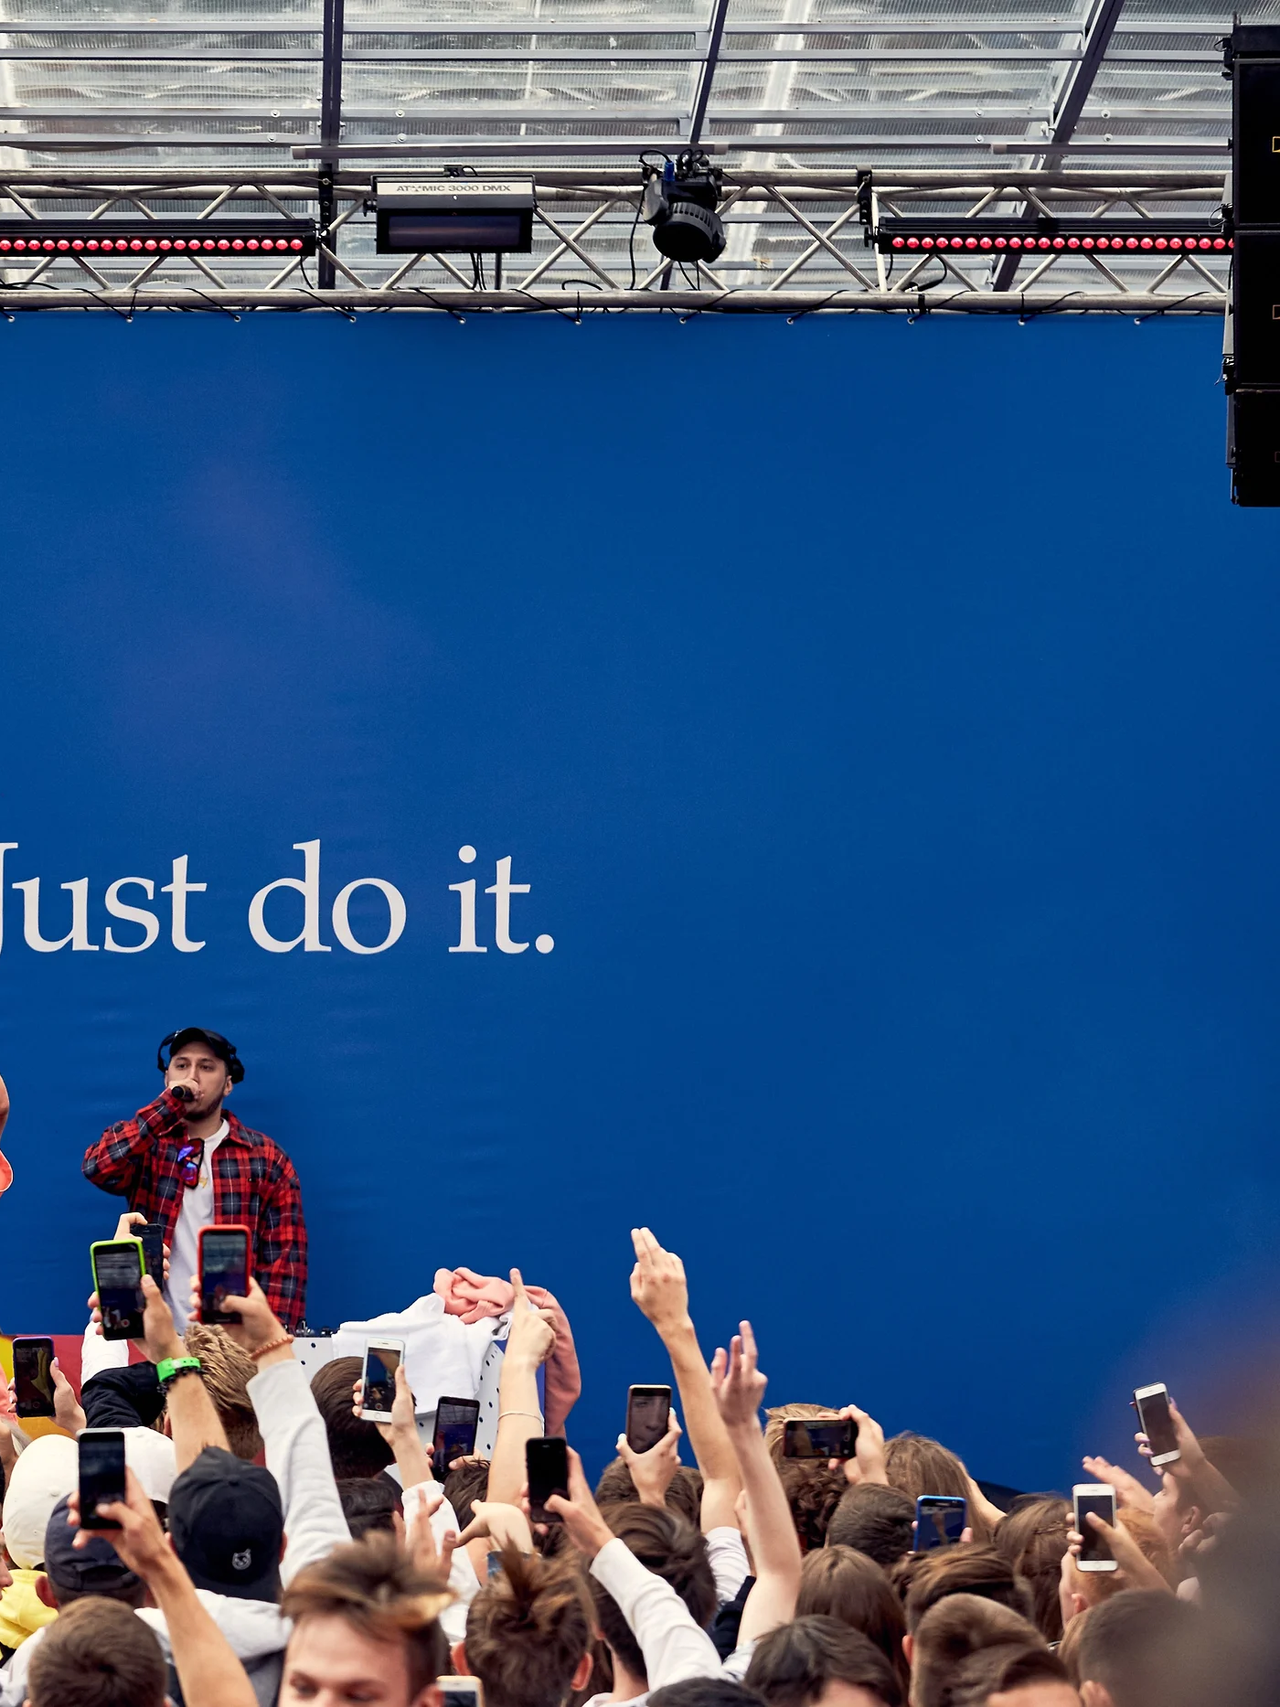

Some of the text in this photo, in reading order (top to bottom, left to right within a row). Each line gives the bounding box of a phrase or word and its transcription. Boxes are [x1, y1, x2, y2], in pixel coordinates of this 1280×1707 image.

[448, 184, 479, 192] 3000
[482, 184, 511, 192] DMX
[248, 839, 407, 954] do
[449, 845, 555, 953] it.
